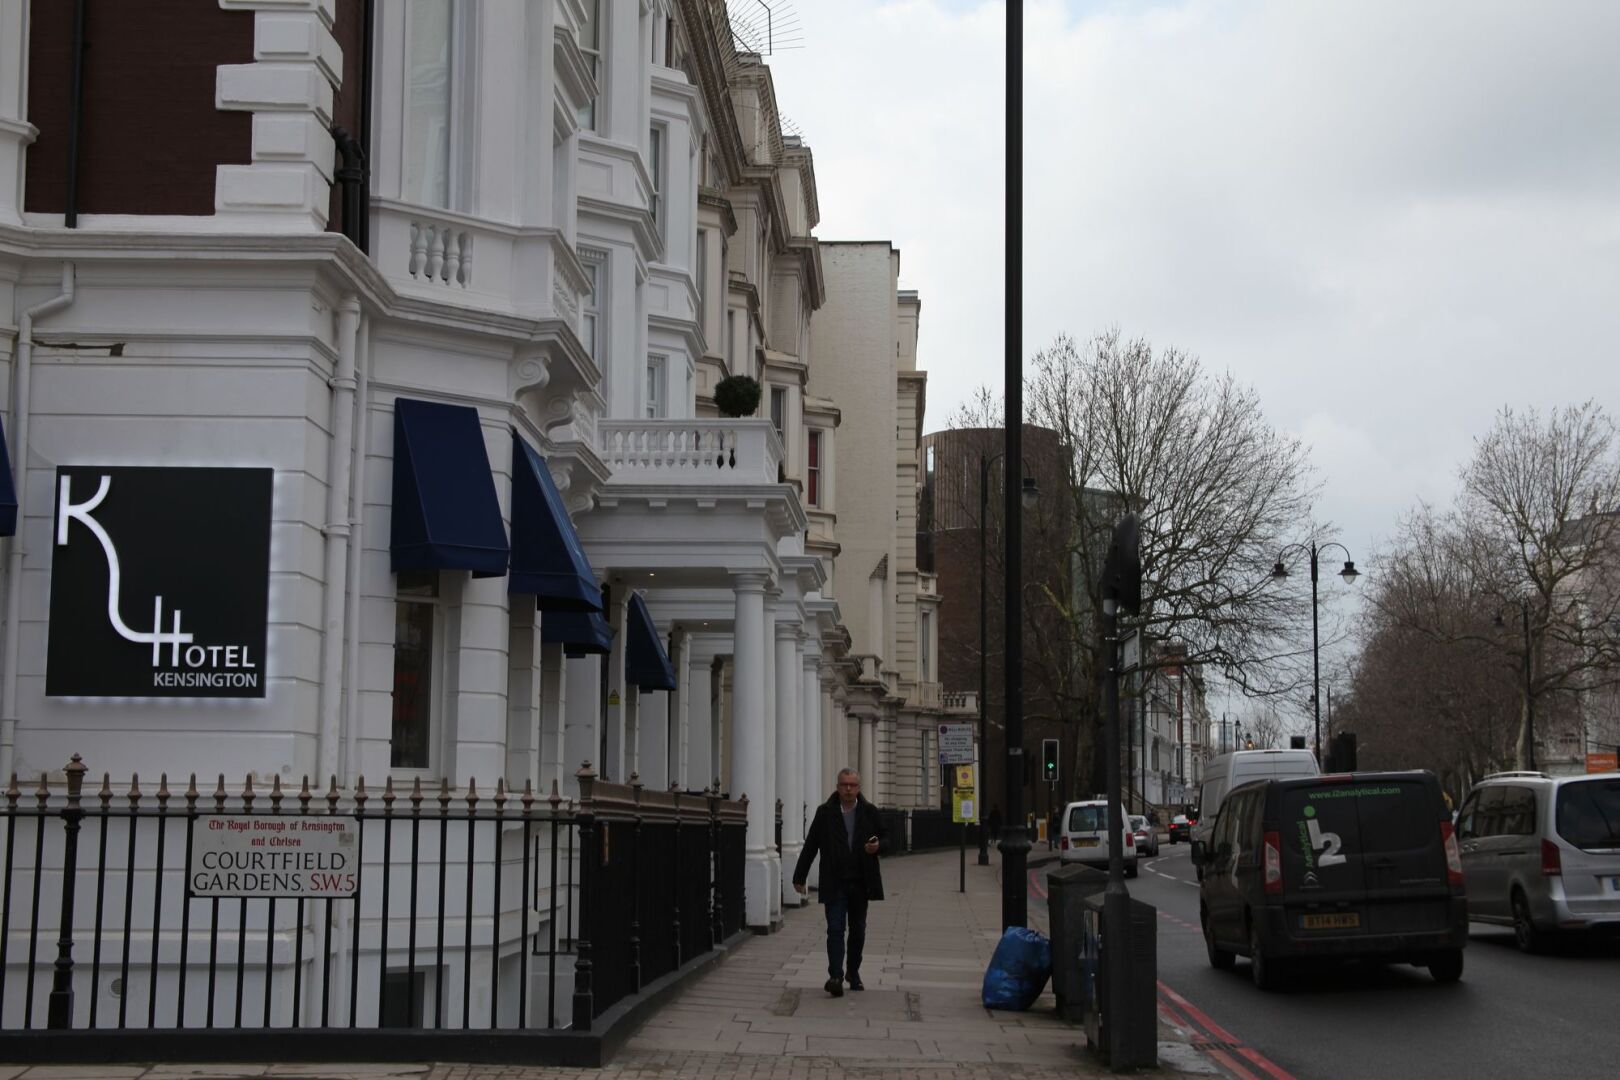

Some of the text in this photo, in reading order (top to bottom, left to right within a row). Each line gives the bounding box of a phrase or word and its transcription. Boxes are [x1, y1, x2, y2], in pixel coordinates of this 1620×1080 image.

[151, 596, 256, 667] HOTEL
[153, 672, 257, 688] KENSINGTON
[1309, 787, 1401, 798] www.i2analytical.com
[209, 819, 345, 833] The Royal Borough of Kensington
[251, 836, 301, 847] and Chelsea
[202, 851, 346, 870] COURTFIELD
